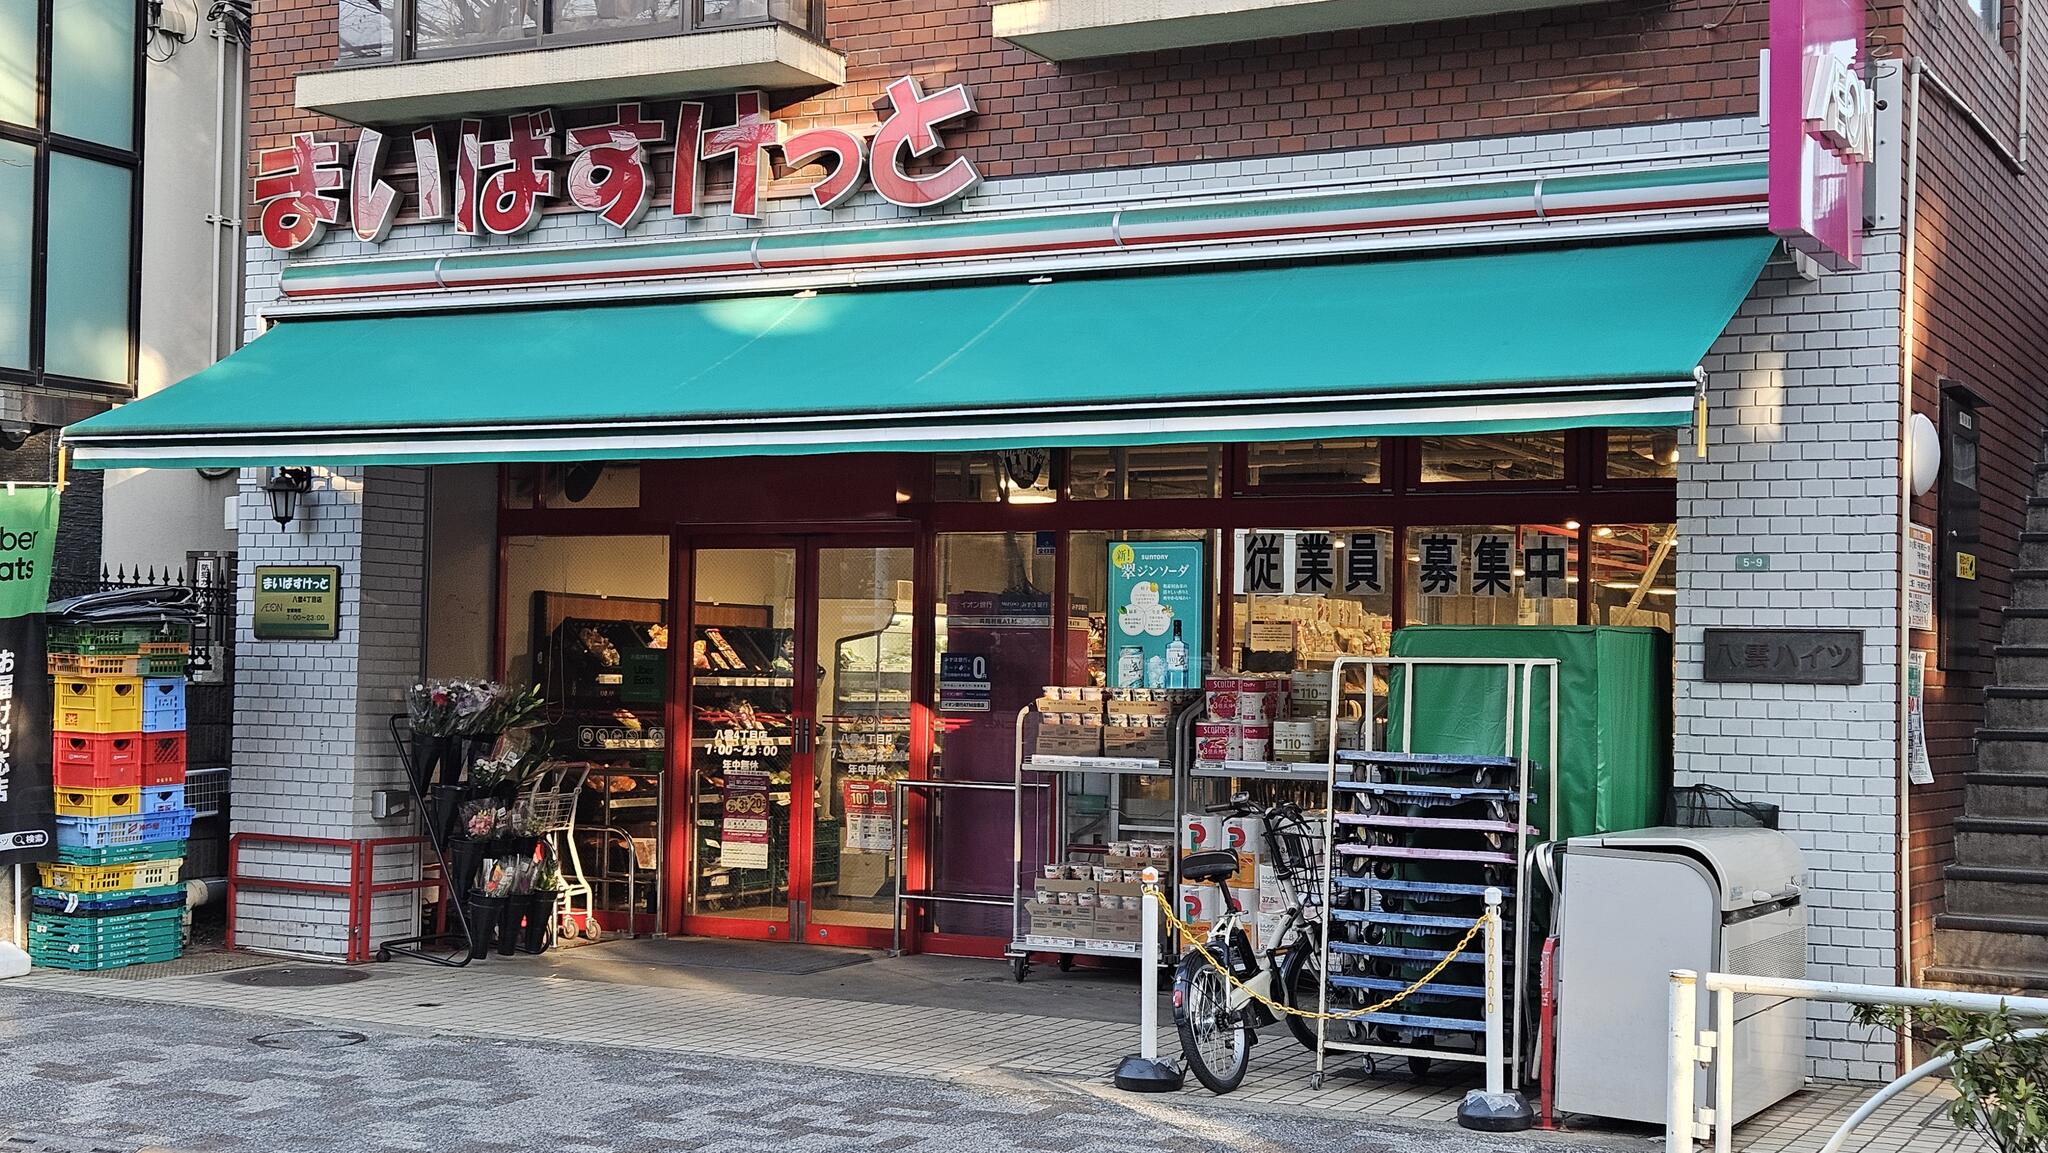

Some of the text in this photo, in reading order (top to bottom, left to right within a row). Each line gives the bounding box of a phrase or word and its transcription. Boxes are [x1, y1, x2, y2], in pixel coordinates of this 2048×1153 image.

[253, 74, 981, 251] まいばすけっと
[0, 526, 39, 551] ber
[1245, 534, 1566, 598] 従業員 募集中
[1743, 557, 1763, 567] 5-9
[0, 557, 34, 581] ats
[1121, 563, 1190, 579] 翠ジンソーダ
[262, 577, 329, 590] まいばすけっと
[1716, 644, 1852, 669] 八雲ハイツ
[1300, 688, 1319, 699] 110
[714, 729, 768, 740] 八雲4丁目店
[1283, 738, 1301, 749] 110
[722, 759, 759, 771] 年中無休
[848, 764, 887, 776] 年中無休
